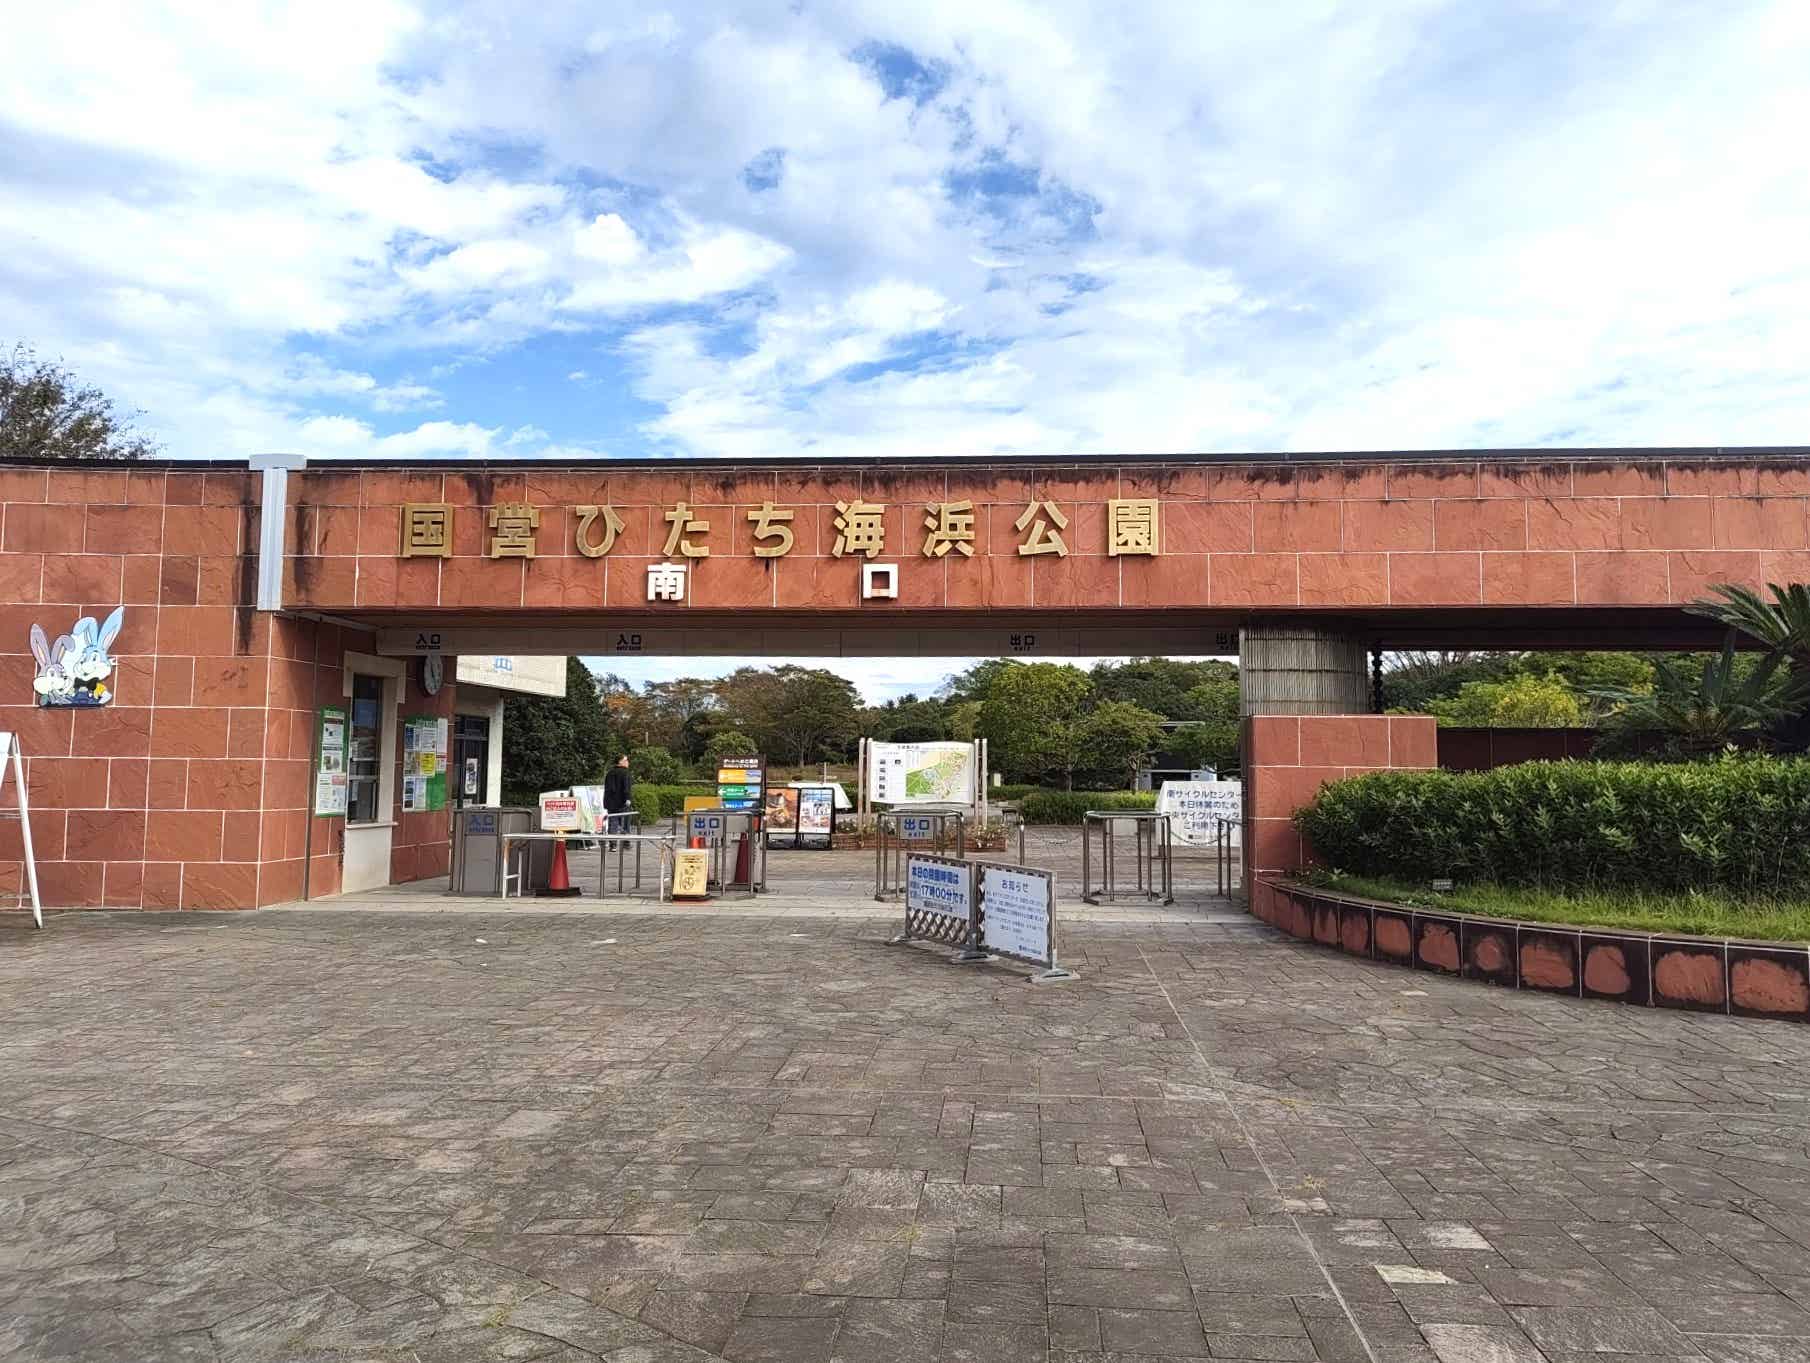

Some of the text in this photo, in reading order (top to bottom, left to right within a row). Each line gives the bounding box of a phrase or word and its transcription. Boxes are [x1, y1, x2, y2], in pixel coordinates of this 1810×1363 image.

[404, 498, 1159, 558] 国営ひたち海浜公園
[647, 562, 898, 601] 南口
[416, 633, 441, 645] 入口
[616, 634, 641, 645] 入口
[1010, 634, 1034, 646] 出口
[694, 817, 720, 829] 出口
[903, 818, 930, 831] 出口
